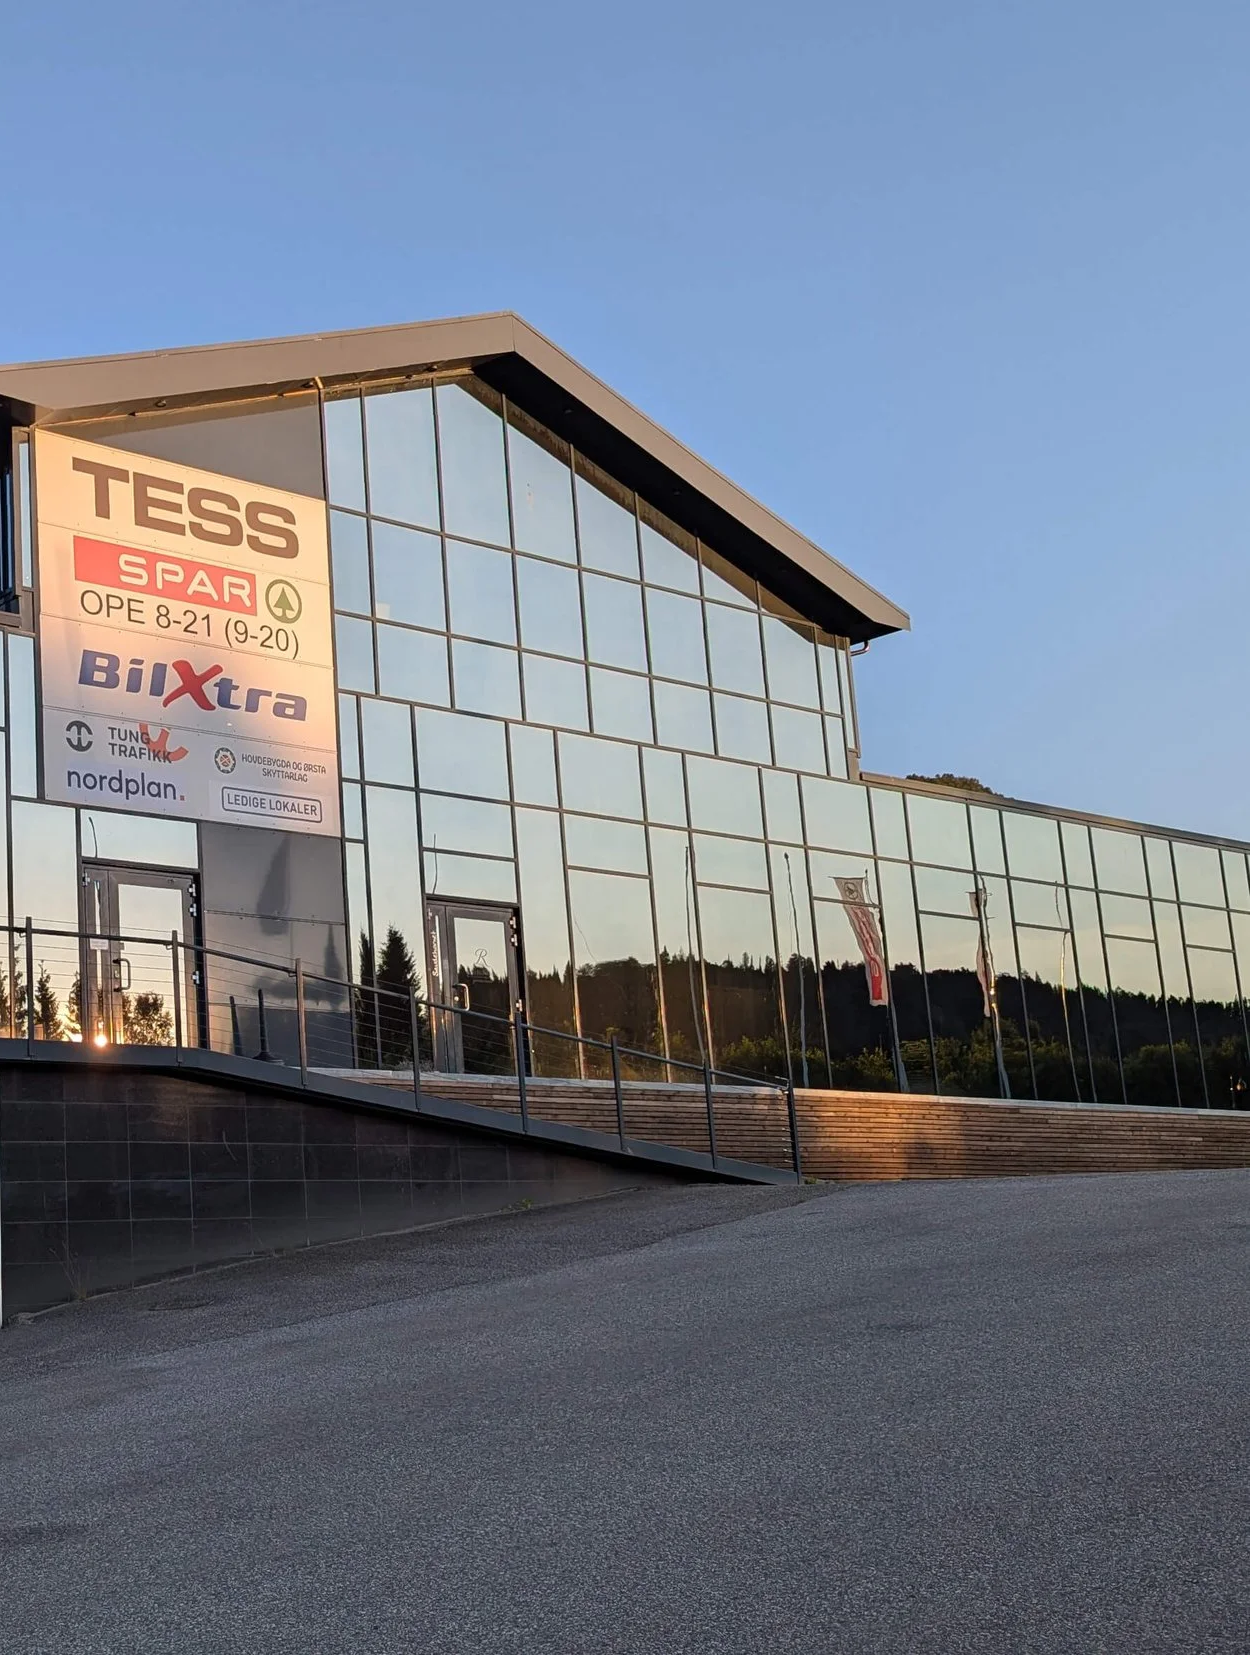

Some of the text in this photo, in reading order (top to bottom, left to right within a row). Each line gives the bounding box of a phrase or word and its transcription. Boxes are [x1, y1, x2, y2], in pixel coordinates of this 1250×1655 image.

[72, 456, 299, 559] TESS
[118, 552, 252, 608] SPAR
[80, 589, 299, 660] OPE 8-21 (9-20)
[78, 649, 308, 722] BilXtra
[108, 726, 151, 745] TUNG
[108, 742, 173, 764] TRAFIKK
[241, 753, 326, 774] HOVDEBYGDA OG ØRSTA
[262, 768, 308, 783] SKYTTARLAG
[227, 793, 318, 816] LEDIGE LOKALER
